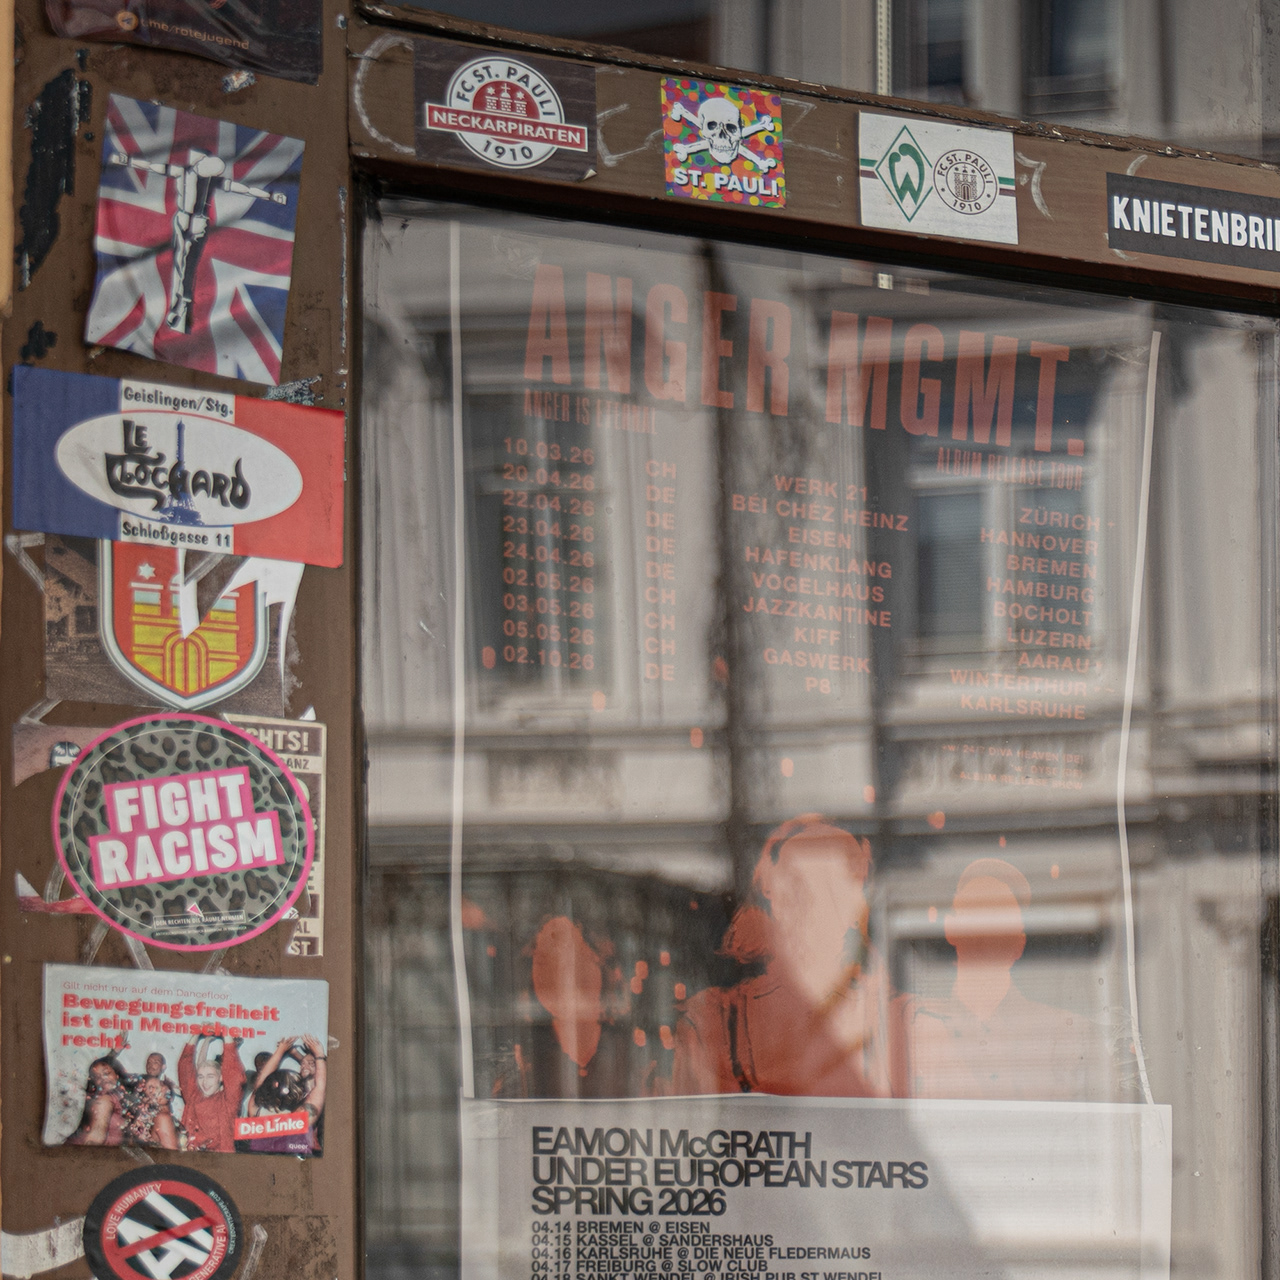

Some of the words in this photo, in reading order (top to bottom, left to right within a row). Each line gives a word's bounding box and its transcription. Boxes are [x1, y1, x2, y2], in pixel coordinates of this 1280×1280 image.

[455, 80, 477, 103] FC
[475, 64, 501, 84] ST.
[506, 66, 556, 117] PAULI
[432, 110, 582, 145] NECKARPIRATEN
[482, 139, 534, 162] 1910
[674, 168, 706, 188] ST.
[714, 175, 781, 197] PAULI
[937, 162, 948, 177] FC
[945, 153, 962, 164] ST.
[964, 153, 994, 185] PAULI
[952, 199, 982, 212] 1910
[523, 262, 793, 417] ANGER
[824, 309, 1085, 457] MGMT.
[123, 385, 235, 418] Geislingen/Stg.
[774, 473, 839, 499] WERK
[846, 484, 869, 502] 21
[122, 521, 209, 547] Schloßgasse
[215, 533, 232, 548] 11
[787, 525, 852, 551] EISEN
[744, 545, 893, 580] HAFENKLANG
[743, 595, 892, 629] JAZZKANTINE
[113, 772, 246, 834] FIGHT
[97, 817, 278, 886] RACISM
[62, 992, 281, 1024] Bewegungsfreiheit
[62, 1011, 93, 1028] ist
[99, 1013, 134, 1031] ein
[140, 1017, 267, 1039] Menschen-
[62, 1031, 132, 1050] recht.
[240, 1120, 264, 1136] Die
[266, 1116, 305, 1133] Linke
[288, 1142, 309, 1152] queer
[531, 1126, 654, 1157] EAMON
[659, 1127, 812, 1159] McGRATH
[532, 1156, 649, 1187] UNDER
[653, 1158, 828, 1188] EUROPEAN
[832, 1160, 929, 1189] STARS
[106, 1213, 121, 1241] LOVE
[114, 1183, 163, 1217] HUMANITY
[531, 1186, 654, 1217] SPRING
[658, 1187, 728, 1217] 2026
[531, 1221, 572, 1234] 04.14
[576, 1221, 644, 1234] BREMEN
[648, 1221, 661, 1234] @
[665, 1221, 711, 1234] EISEN
[531, 1260, 572, 1273] 04.17
[576, 1260, 657, 1273] FREIBURG
[661, 1260, 674, 1272] @
[677, 1260, 723, 1272] SLOW
[726, 1259, 769, 1272] CLUB
